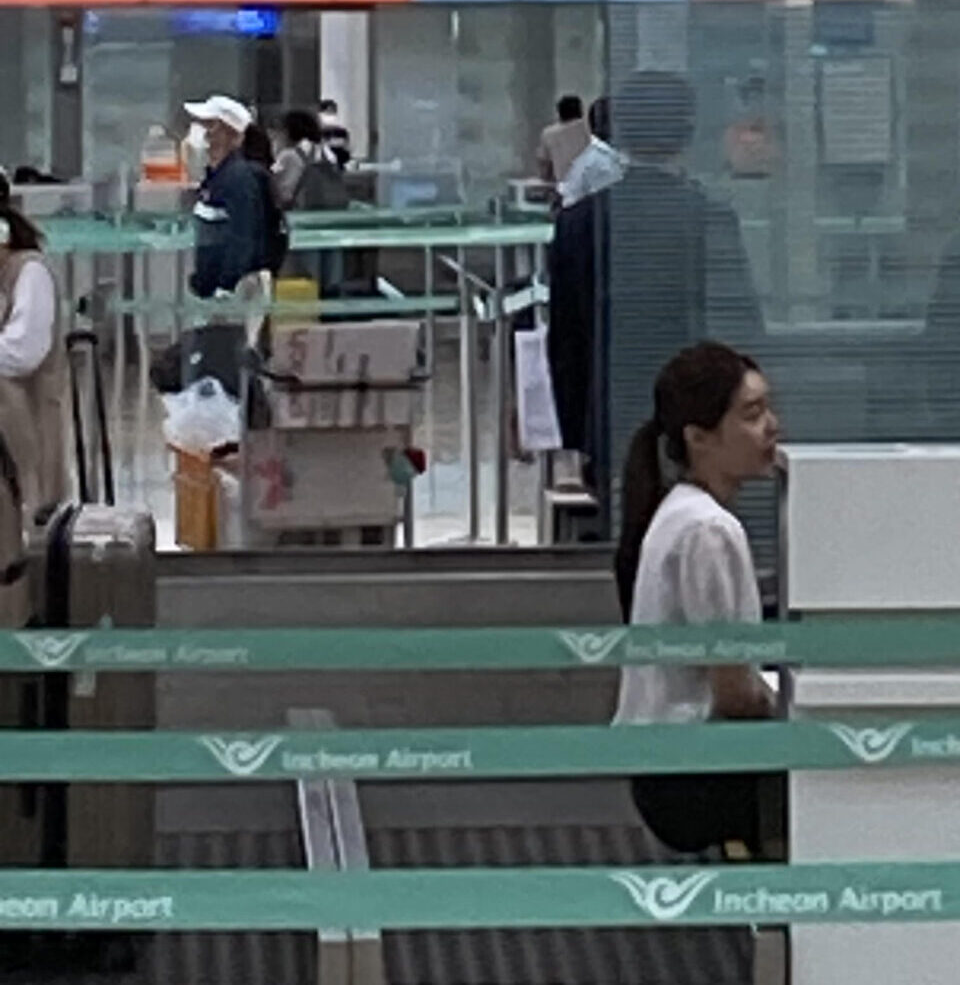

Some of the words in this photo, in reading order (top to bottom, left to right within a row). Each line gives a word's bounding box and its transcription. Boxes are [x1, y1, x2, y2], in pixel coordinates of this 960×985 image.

[282, 747, 379, 771] Incheon
[384, 746, 474, 773] Airport
[66, 892, 174, 924] Airport
[713, 887, 829, 914] Incheon
[838, 886, 943, 916] Airport
